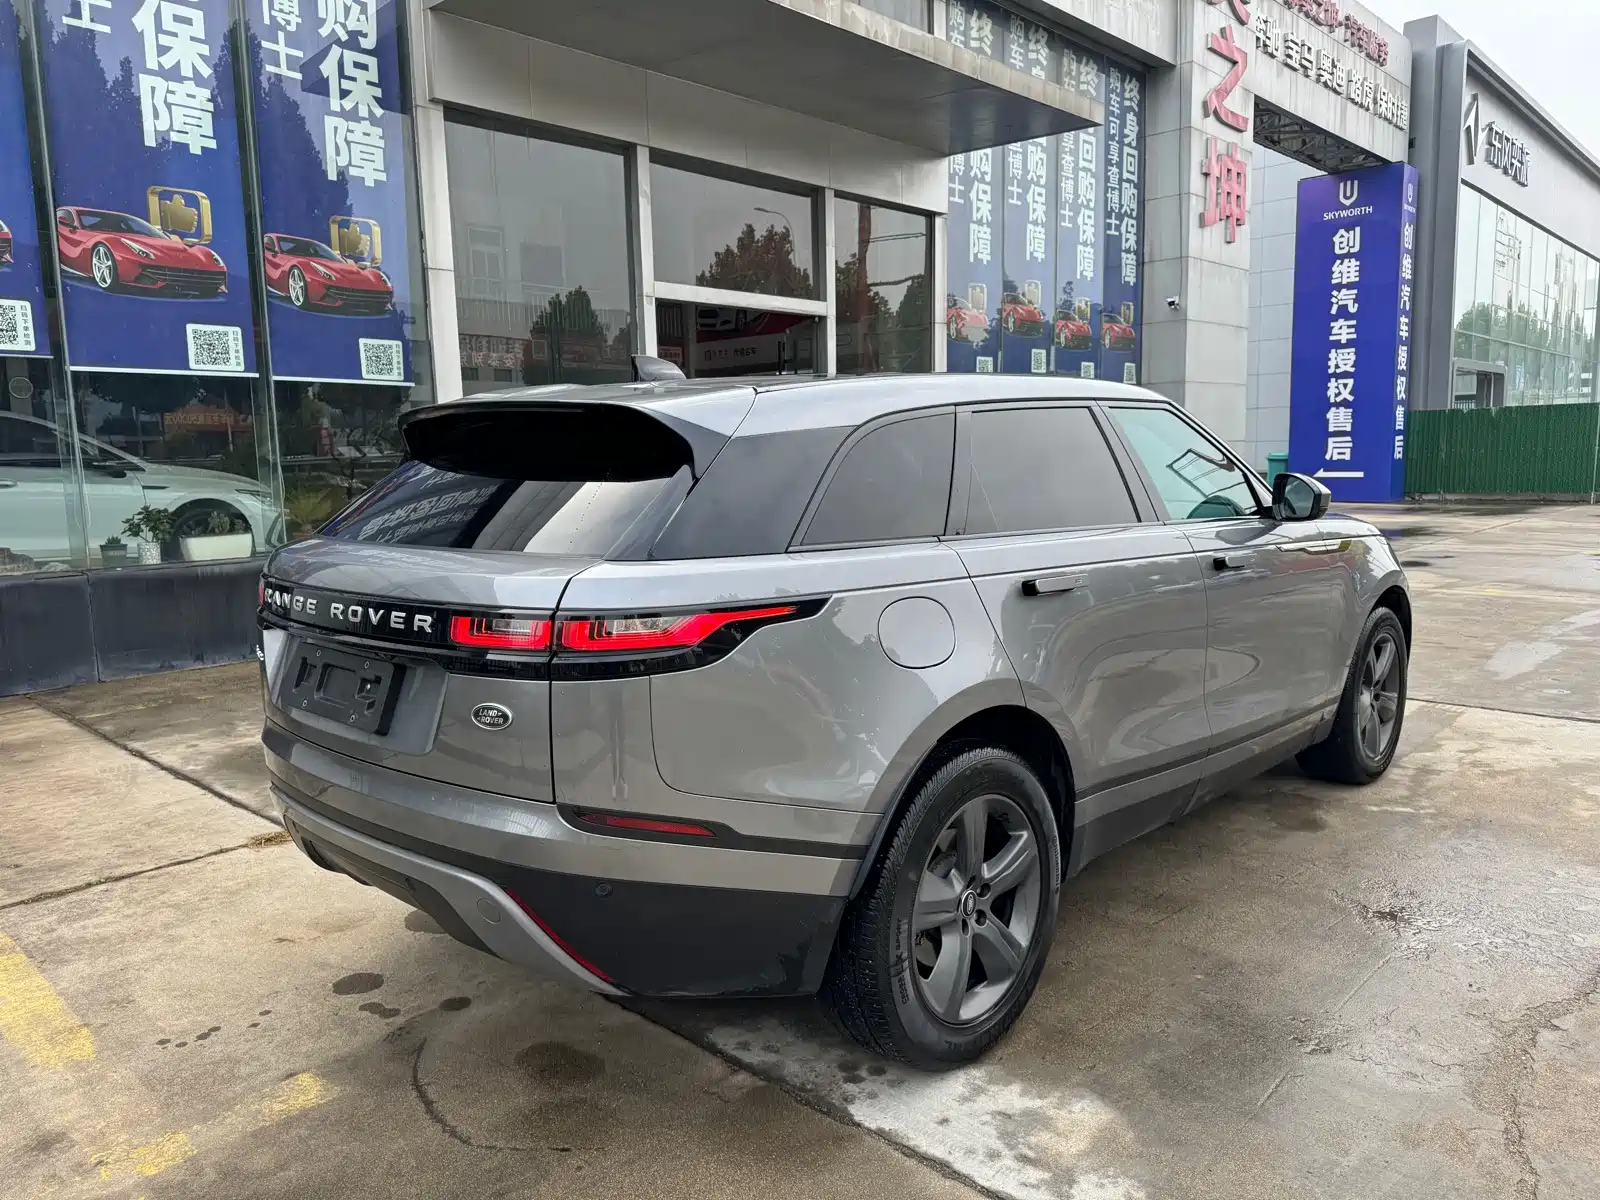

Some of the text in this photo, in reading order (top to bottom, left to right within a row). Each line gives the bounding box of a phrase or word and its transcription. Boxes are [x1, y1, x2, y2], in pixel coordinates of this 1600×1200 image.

[318, 0, 387, 187] 购保障
[1200, 0, 1250, 244] 之坤
[1255, 8, 1408, 131] 奔驰 宝马 奥迪 路虎 保时捷
[1026, 136, 1047, 263] 购保障
[1120, 74, 1140, 287] 终身回购保障
[1323, 206, 1373, 221] SKYWORTH
[1324, 226, 1361, 461] 创维汽车授权售后
[1394, 222, 1414, 460] 创维汽车授权售后
[264, 588, 433, 633] RANGE ROVER
[480, 716, 504, 725] ROVER
